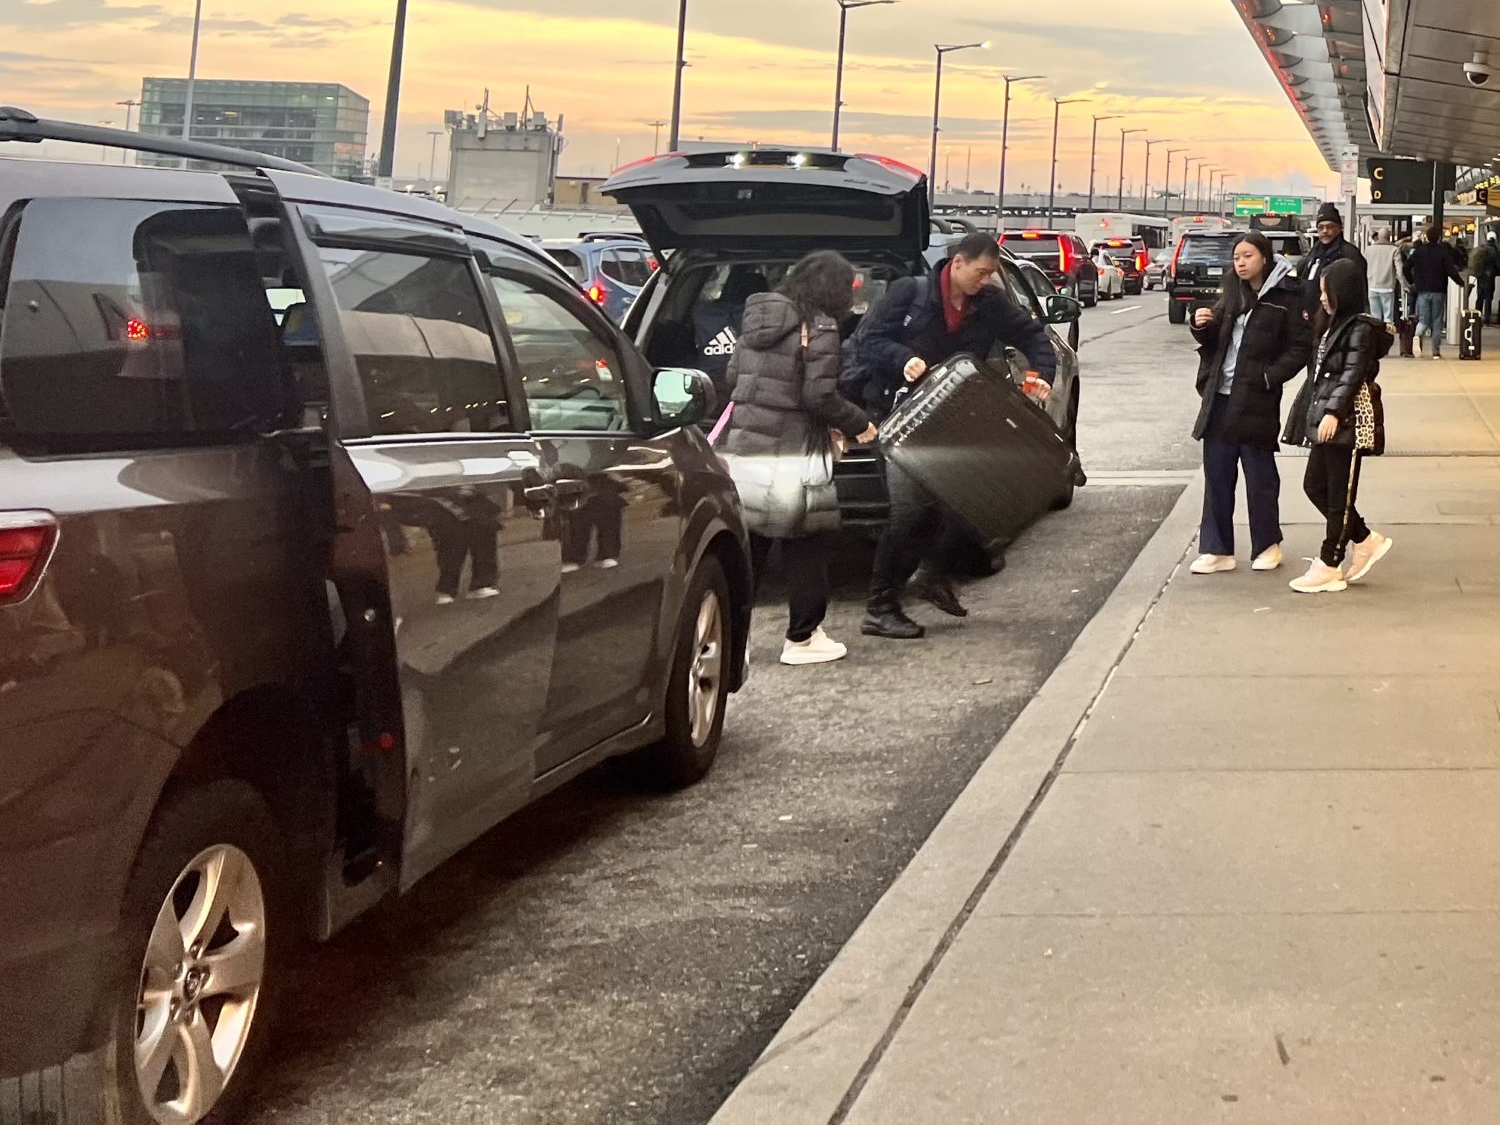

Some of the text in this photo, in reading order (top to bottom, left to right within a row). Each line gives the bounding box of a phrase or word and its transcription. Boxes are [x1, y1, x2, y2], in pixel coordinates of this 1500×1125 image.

[1373, 167, 1384, 179] C
[1373, 190, 1382, 200] D
[703, 343, 736, 355] adid
